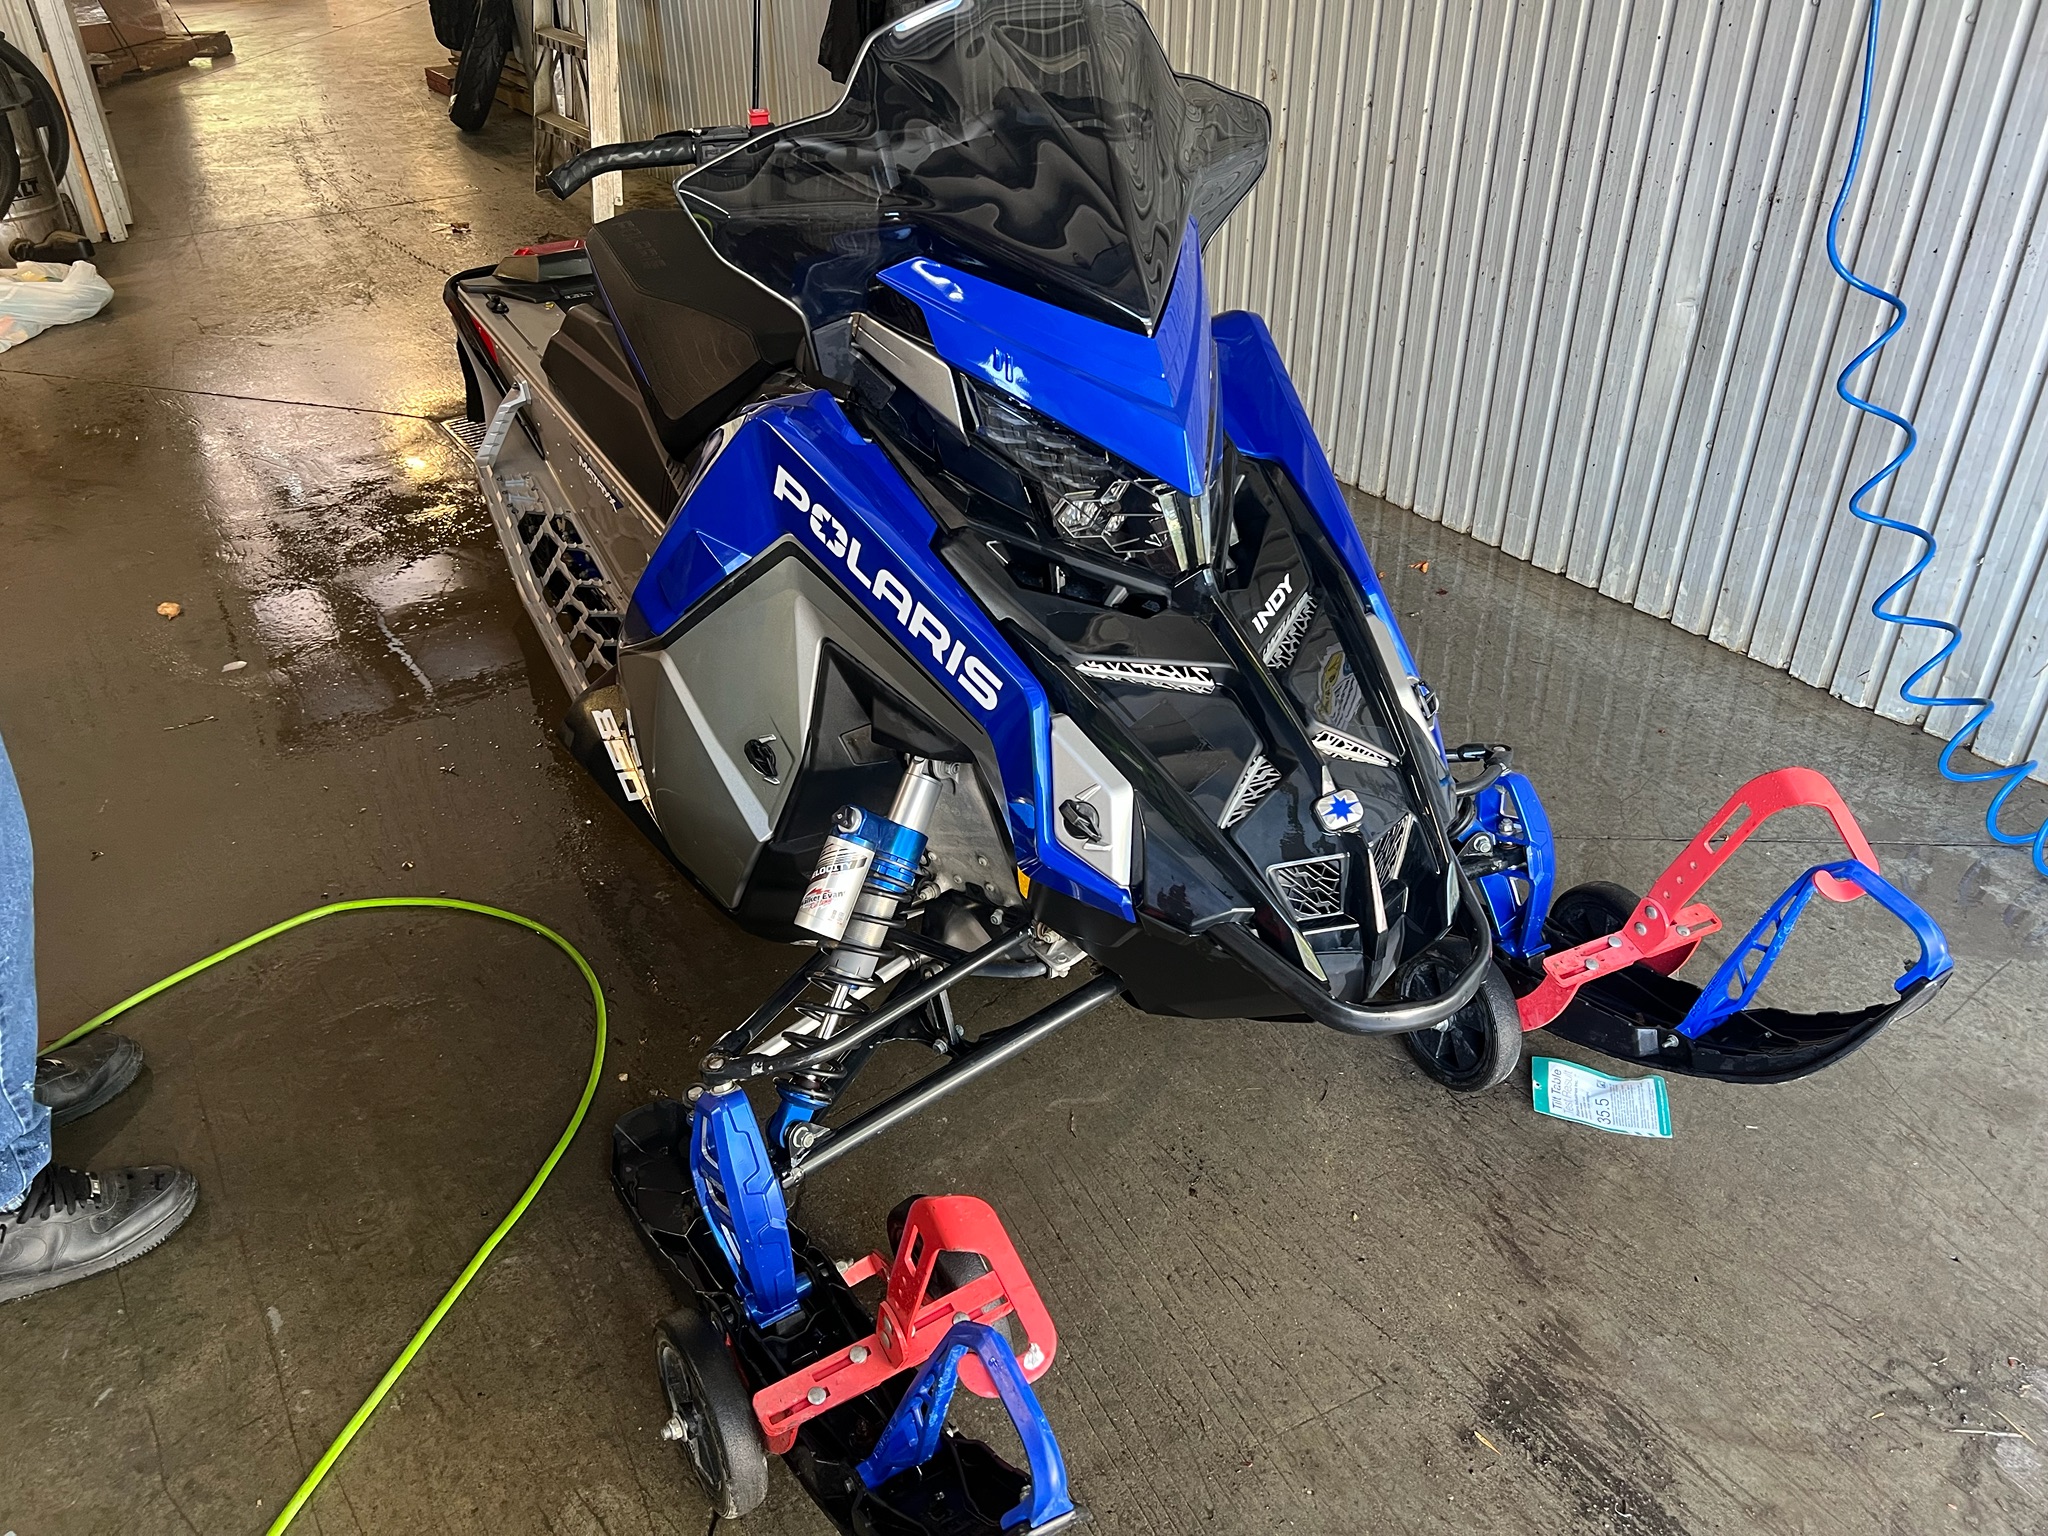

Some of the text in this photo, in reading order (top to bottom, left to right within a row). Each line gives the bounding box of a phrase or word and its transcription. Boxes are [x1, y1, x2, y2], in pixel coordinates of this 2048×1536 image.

[773, 464, 1004, 711] POLARIS
[1251, 572, 1294, 635] INDY
[591, 708, 646, 802] 850
[811, 861, 853, 879] ELOCITY
[1551, 1068, 1562, 1109] Tilt Table
[1561, 1069, 1574, 1114] Test Result
[1595, 1098, 1611, 1125] 35.5
